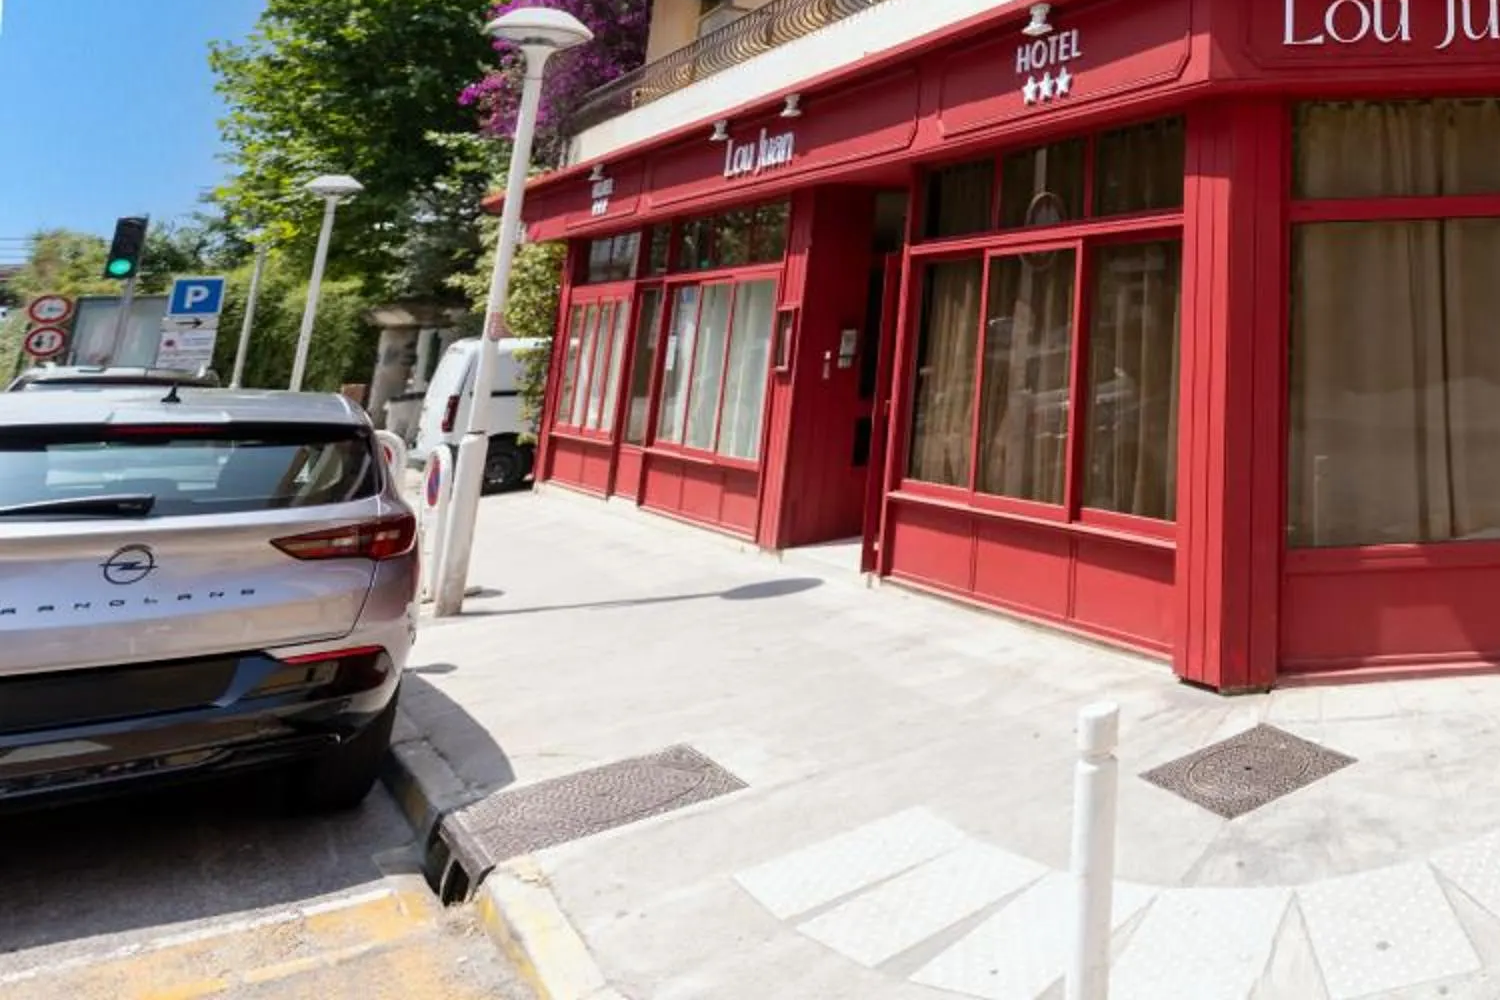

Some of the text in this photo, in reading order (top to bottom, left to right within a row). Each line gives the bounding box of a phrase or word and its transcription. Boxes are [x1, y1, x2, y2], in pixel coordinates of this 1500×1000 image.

[1015, 28, 1082, 73] HOTEL
[723, 127, 794, 177] Lou Juan
[184, 285, 209, 309] P
